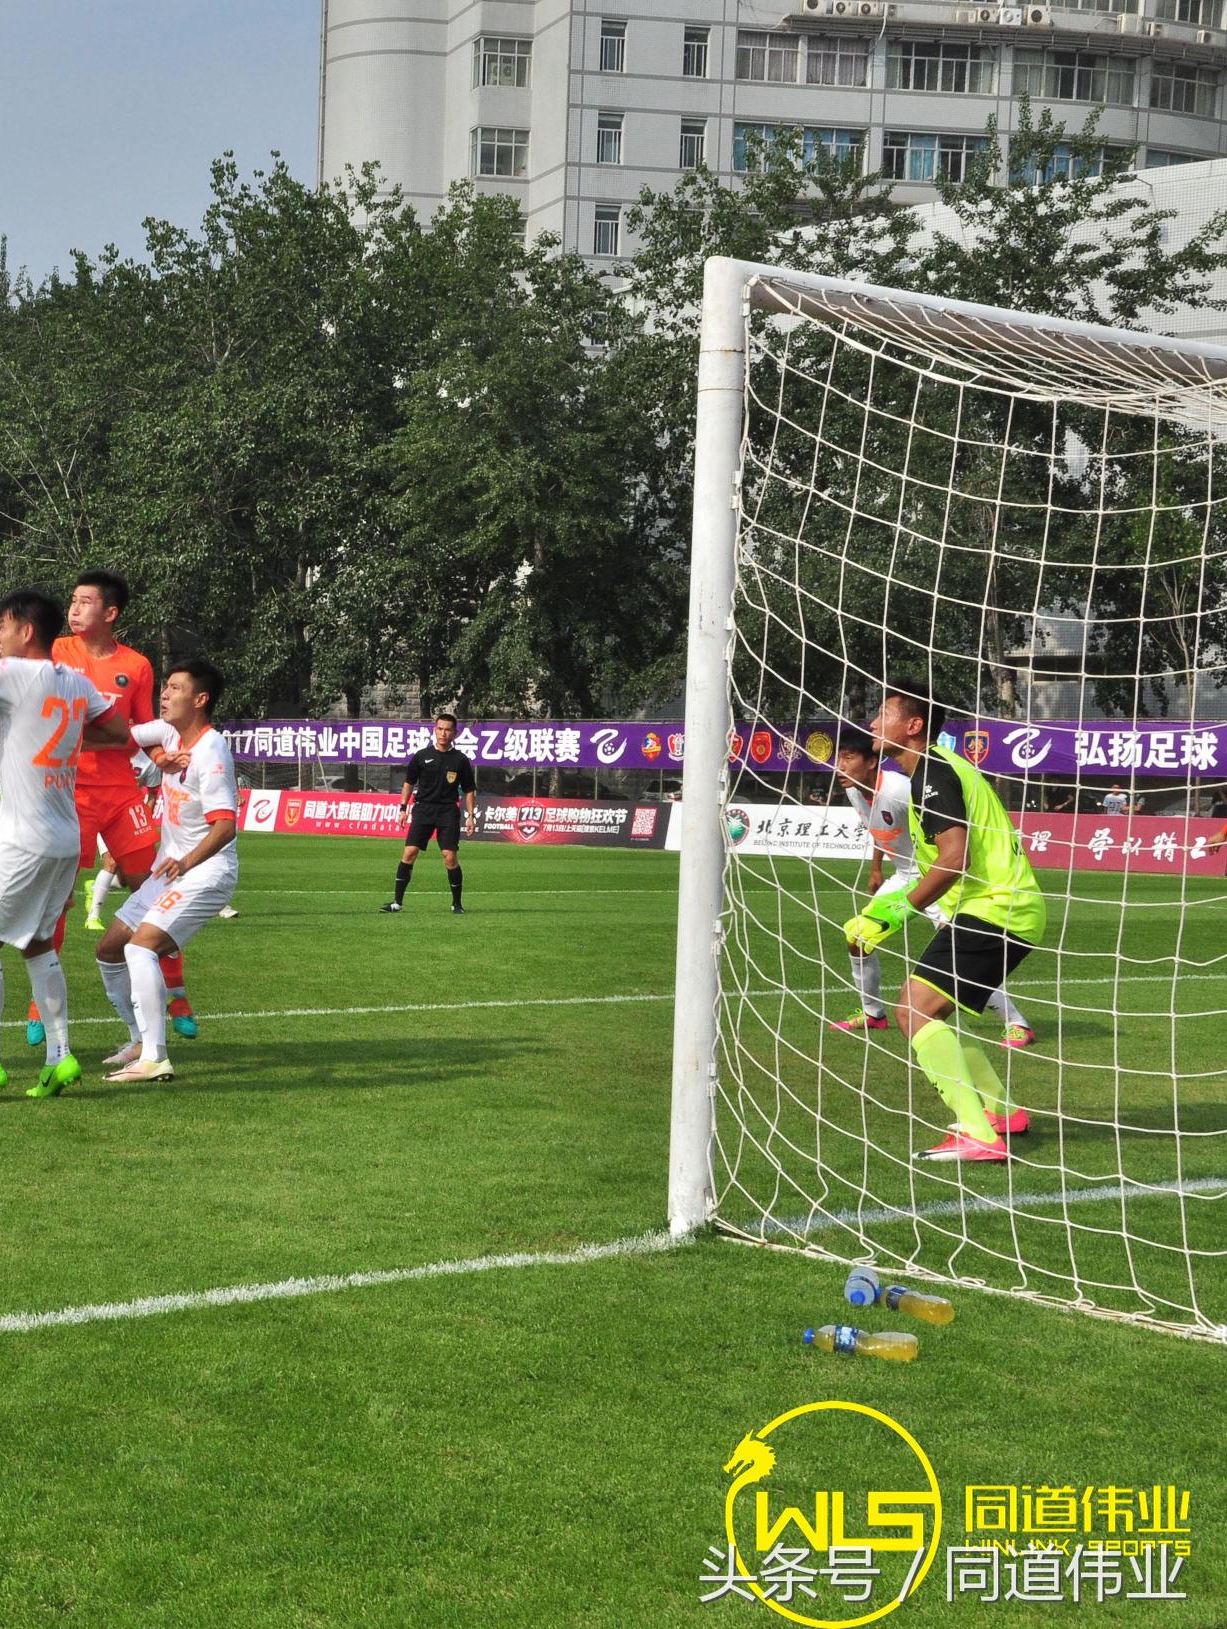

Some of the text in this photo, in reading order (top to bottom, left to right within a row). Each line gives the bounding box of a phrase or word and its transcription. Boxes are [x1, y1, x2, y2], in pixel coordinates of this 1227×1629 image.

[223, 726, 581, 763] 017同道伟业中国足球会乙级联赛
[1075, 731, 1218, 770] 弘扬足球
[129, 805, 148, 829] 13
[484, 823, 514, 831] FOOTBALL
[521, 806, 542, 822] 713
[545, 806, 628, 826] 足球购物狂欢节
[757, 818, 869, 842] 北京理工大学
[754, 839, 777, 847] BEIJING
[823, 842, 866, 850] TECHNOLOGY
